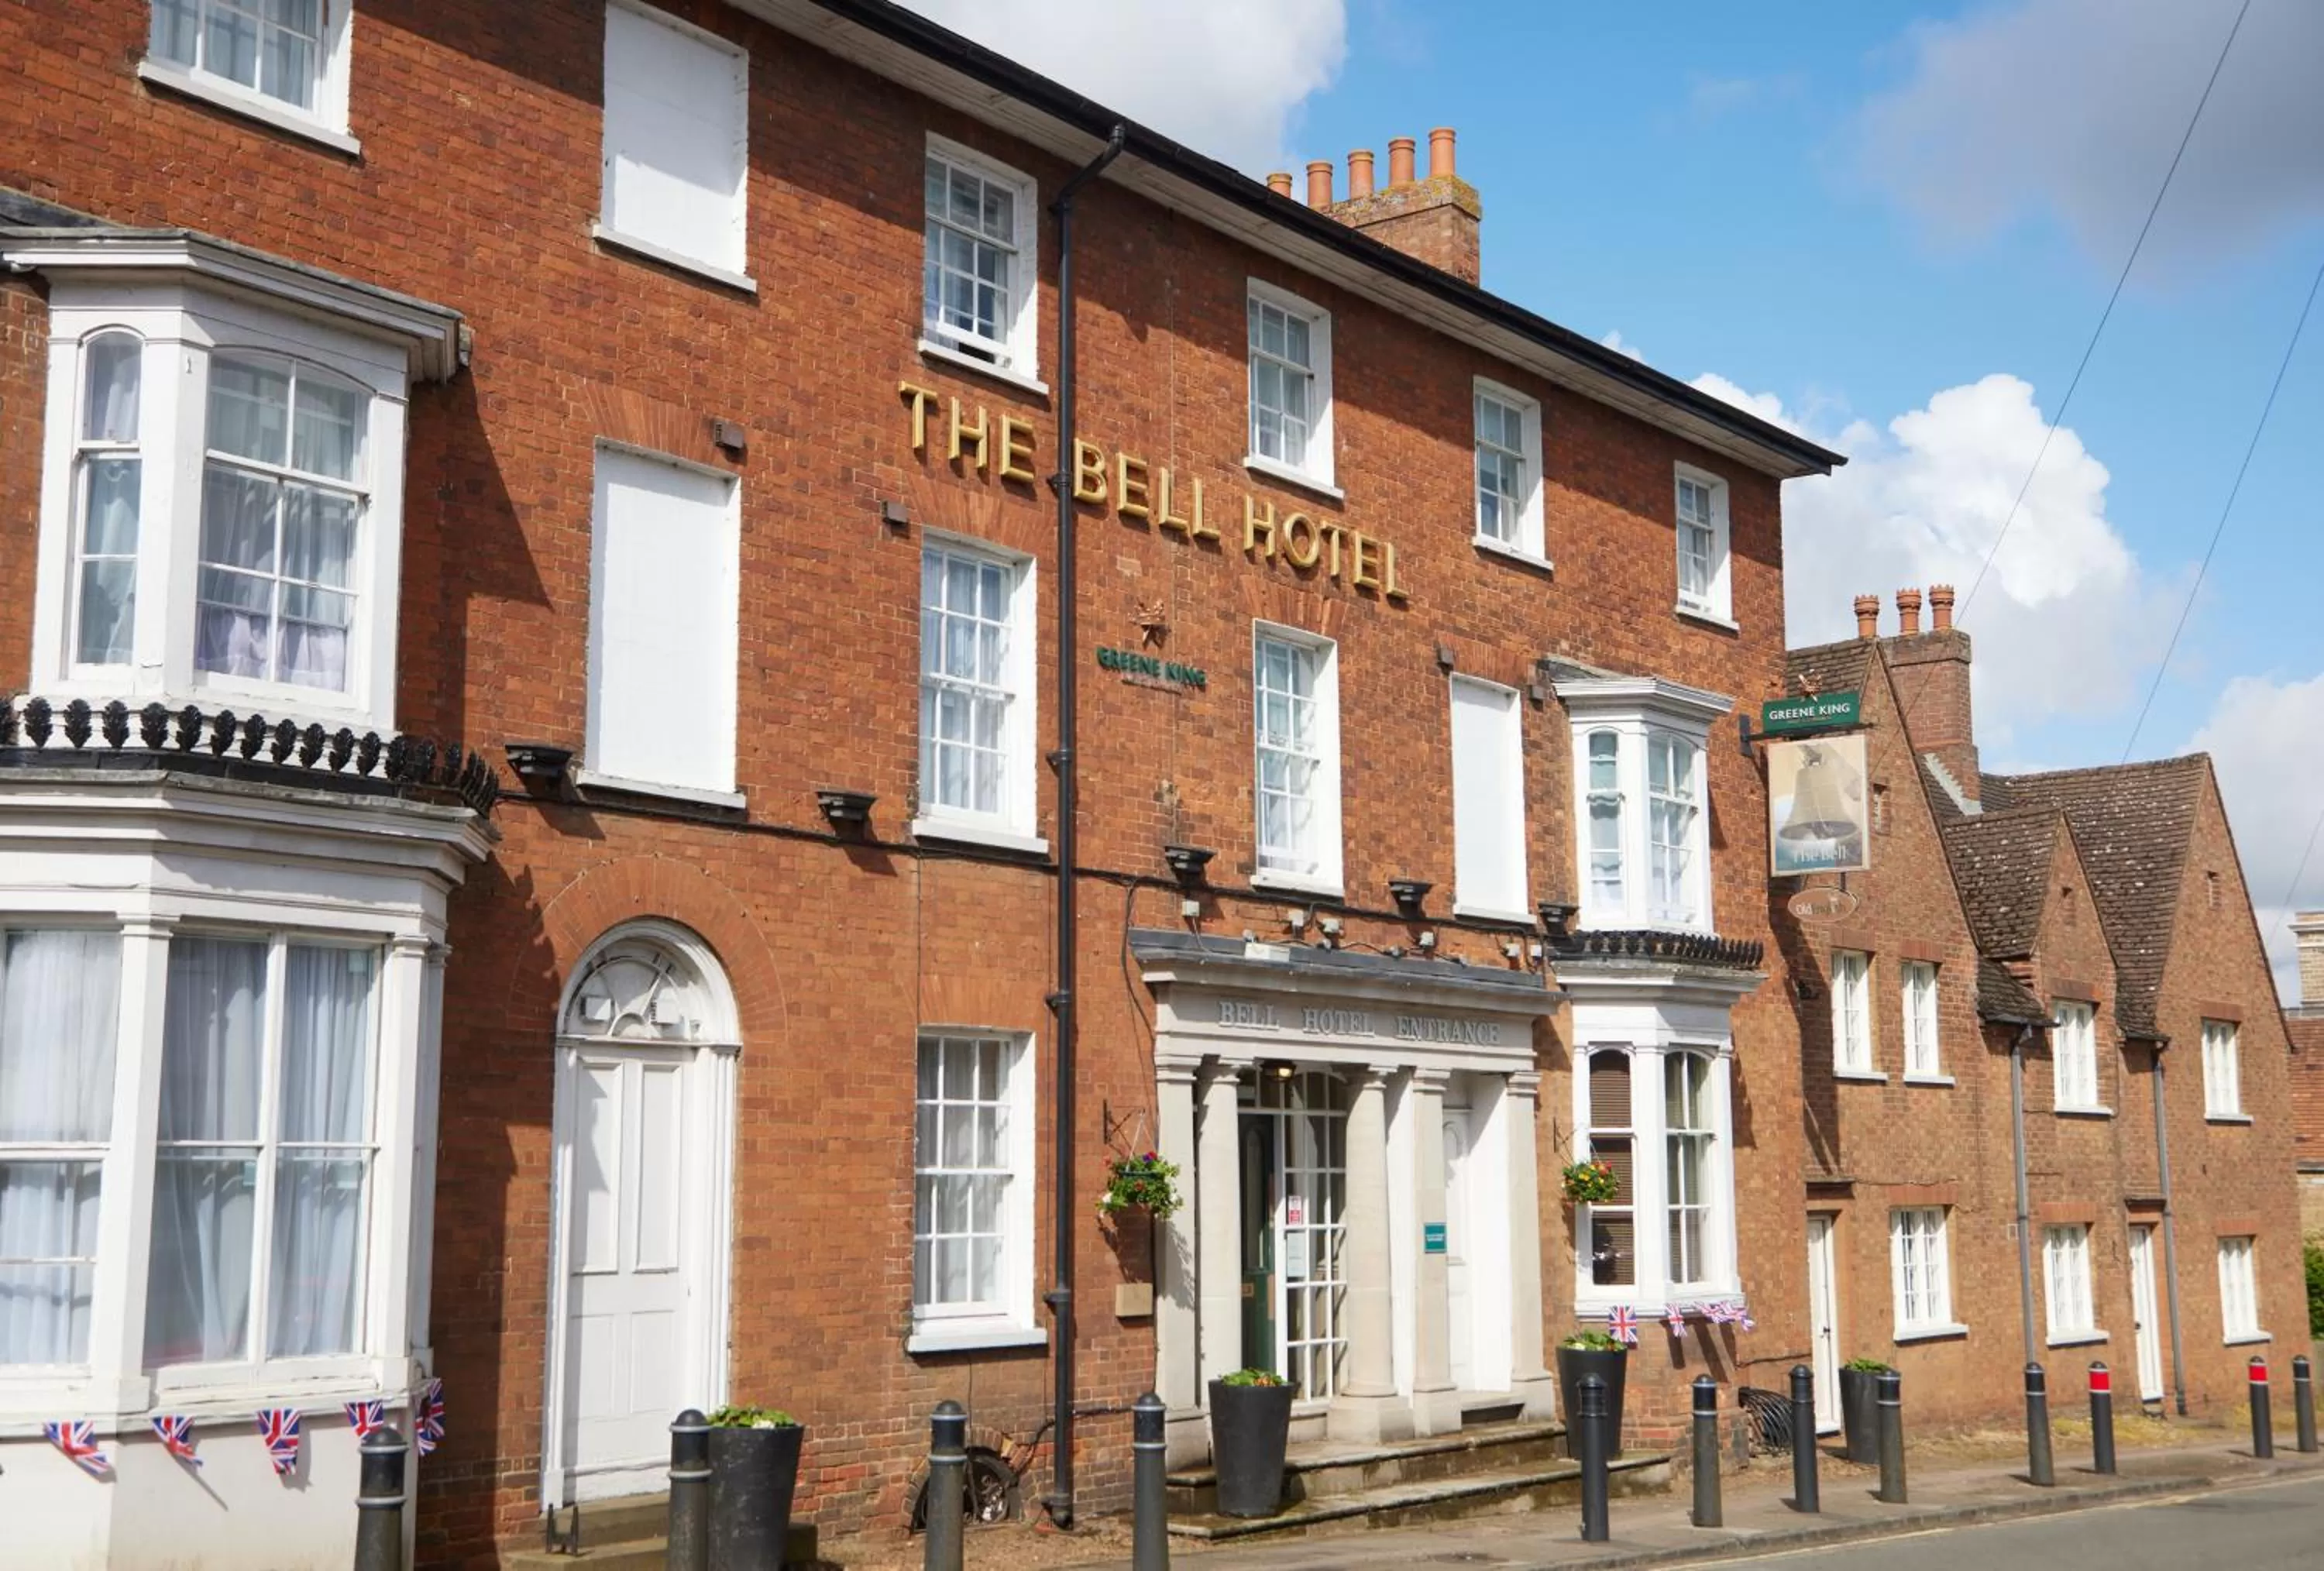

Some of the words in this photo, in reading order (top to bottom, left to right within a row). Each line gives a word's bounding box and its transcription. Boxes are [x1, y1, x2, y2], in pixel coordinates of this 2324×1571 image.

[899, 380, 1034, 483] THE
[1073, 438, 1220, 541] BELL
[1244, 494, 1408, 600] HOTEL
[1097, 647, 1160, 678] GREENE
[1164, 661, 1207, 690] KING
[1769, 706, 1815, 720] GREENE
[1818, 703, 1851, 715] KING
[1219, 1001, 1280, 1031] BELL
[1301, 1006, 1376, 1037] HOTEL
[1395, 1016, 1501, 1046] ENTRANCE
